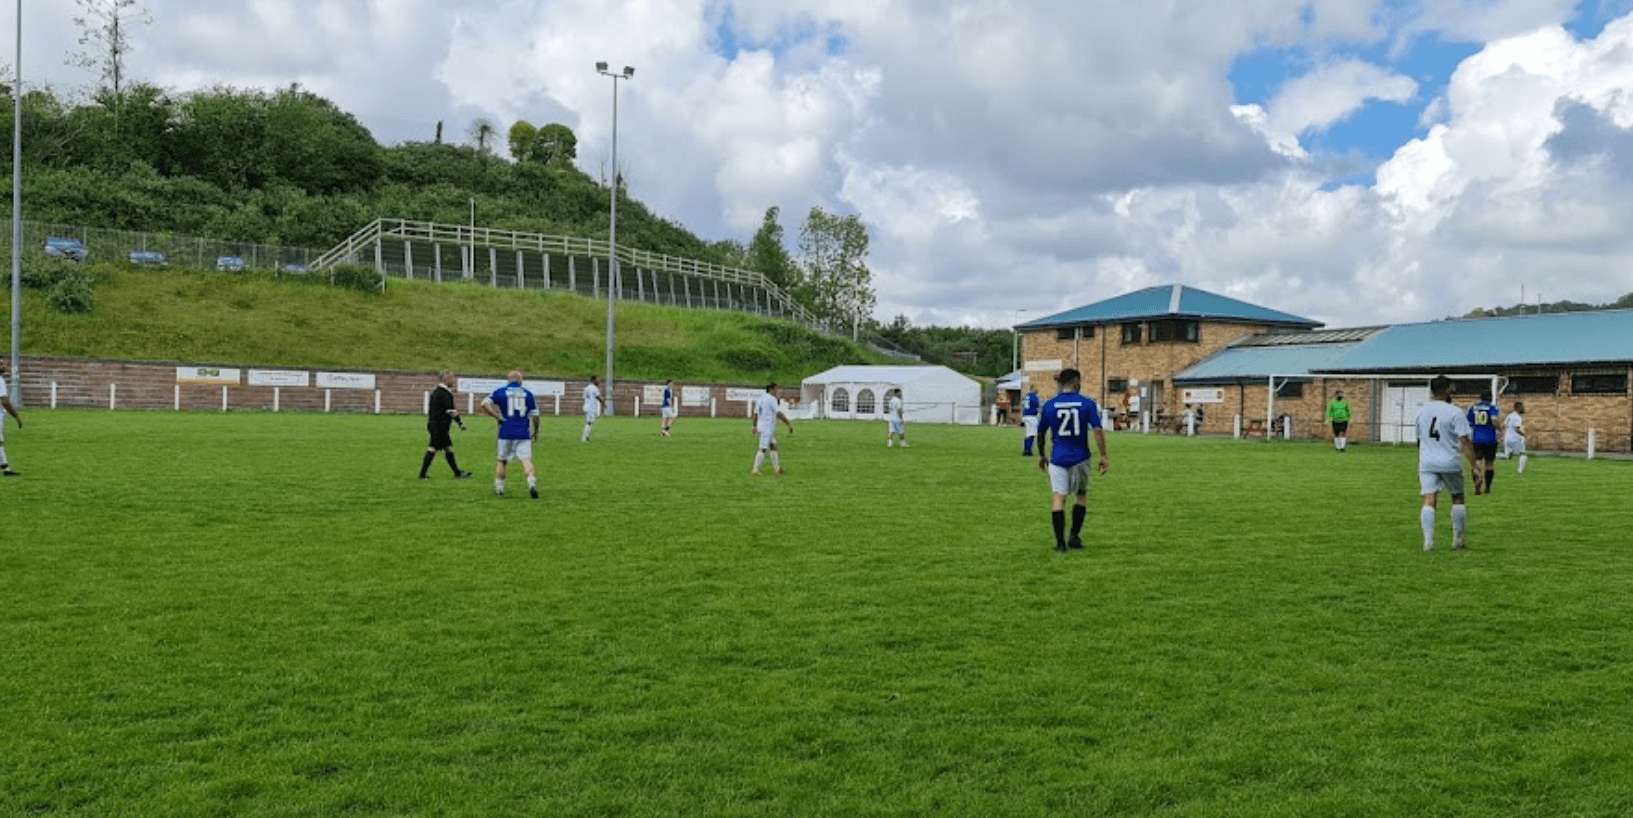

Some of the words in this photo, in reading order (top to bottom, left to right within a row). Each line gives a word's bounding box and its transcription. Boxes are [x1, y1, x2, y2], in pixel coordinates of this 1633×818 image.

[1057, 408, 1080, 436] 21
[1429, 417, 1440, 441] 4
[1474, 411, 1488, 425] 10
